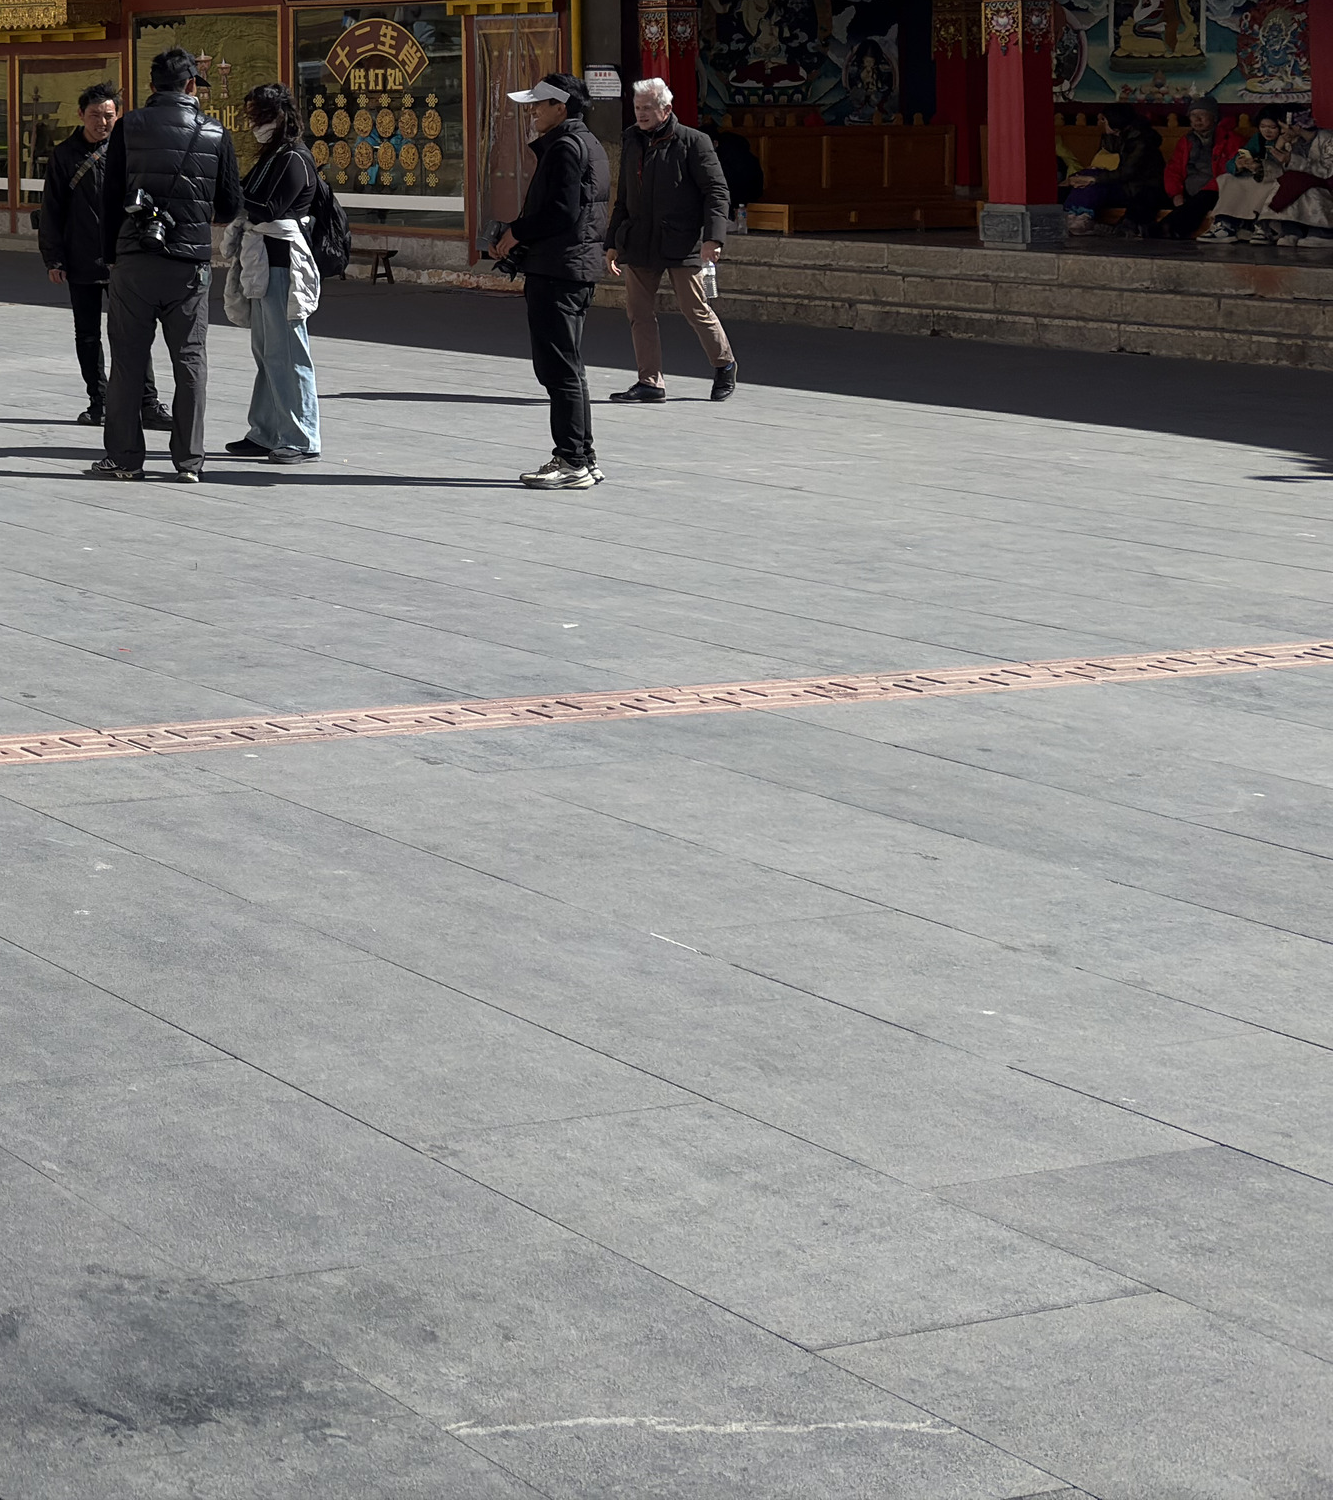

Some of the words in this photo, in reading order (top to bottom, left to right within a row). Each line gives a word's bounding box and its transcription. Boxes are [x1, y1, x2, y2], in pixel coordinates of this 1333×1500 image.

[334, 24, 422, 75] 十二生肖
[349, 67, 404, 91] 供灯处
